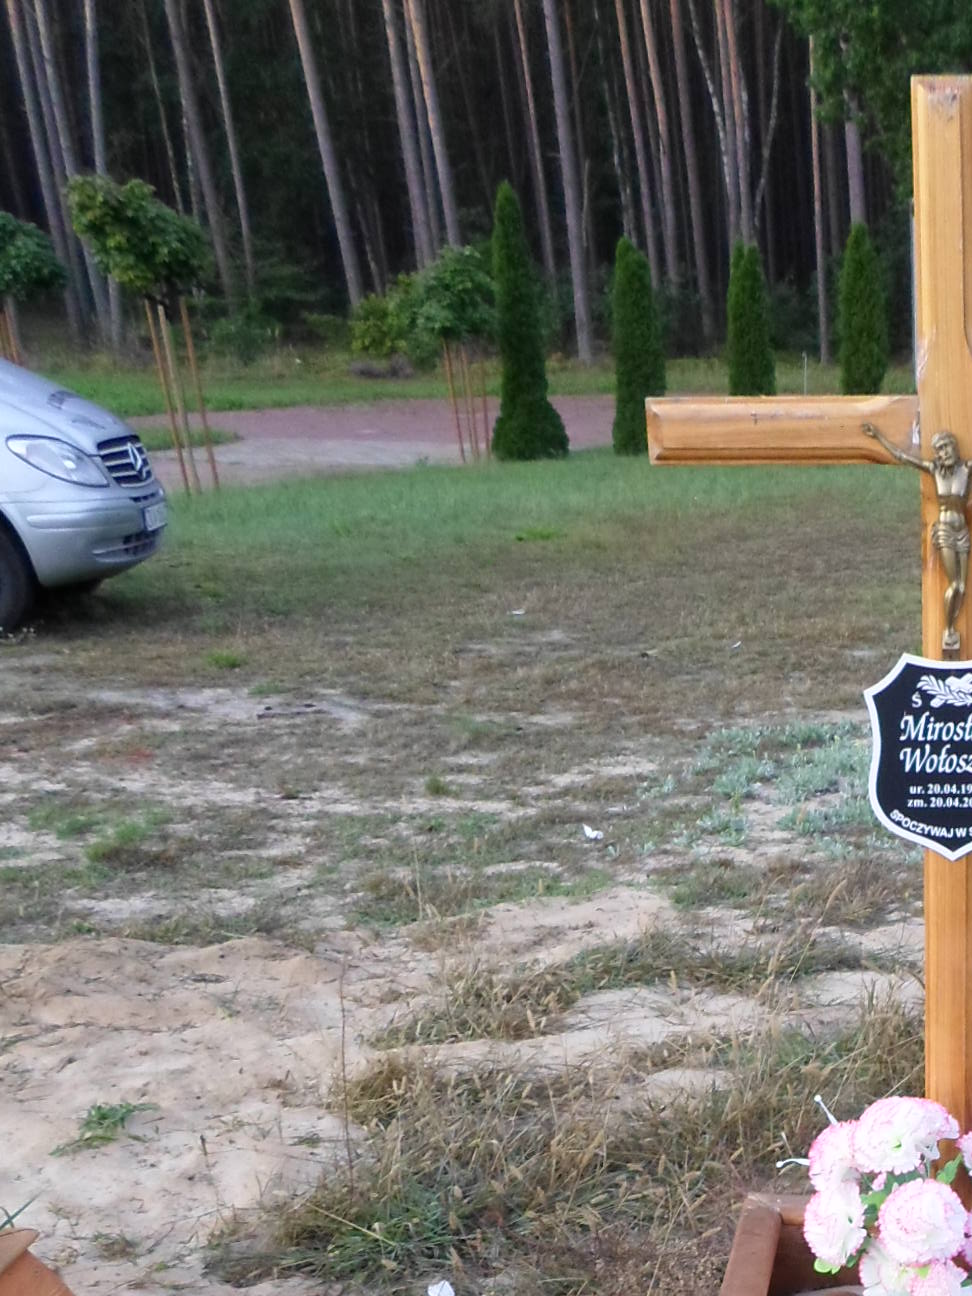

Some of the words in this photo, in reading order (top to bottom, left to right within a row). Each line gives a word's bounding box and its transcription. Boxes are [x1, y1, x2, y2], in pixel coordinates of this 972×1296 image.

[909, 785, 925, 795] ur.
[907, 797, 927, 808] zm.
[889, 809, 954, 838] SPOCZYWAJ
[955, 827, 967, 838] W
